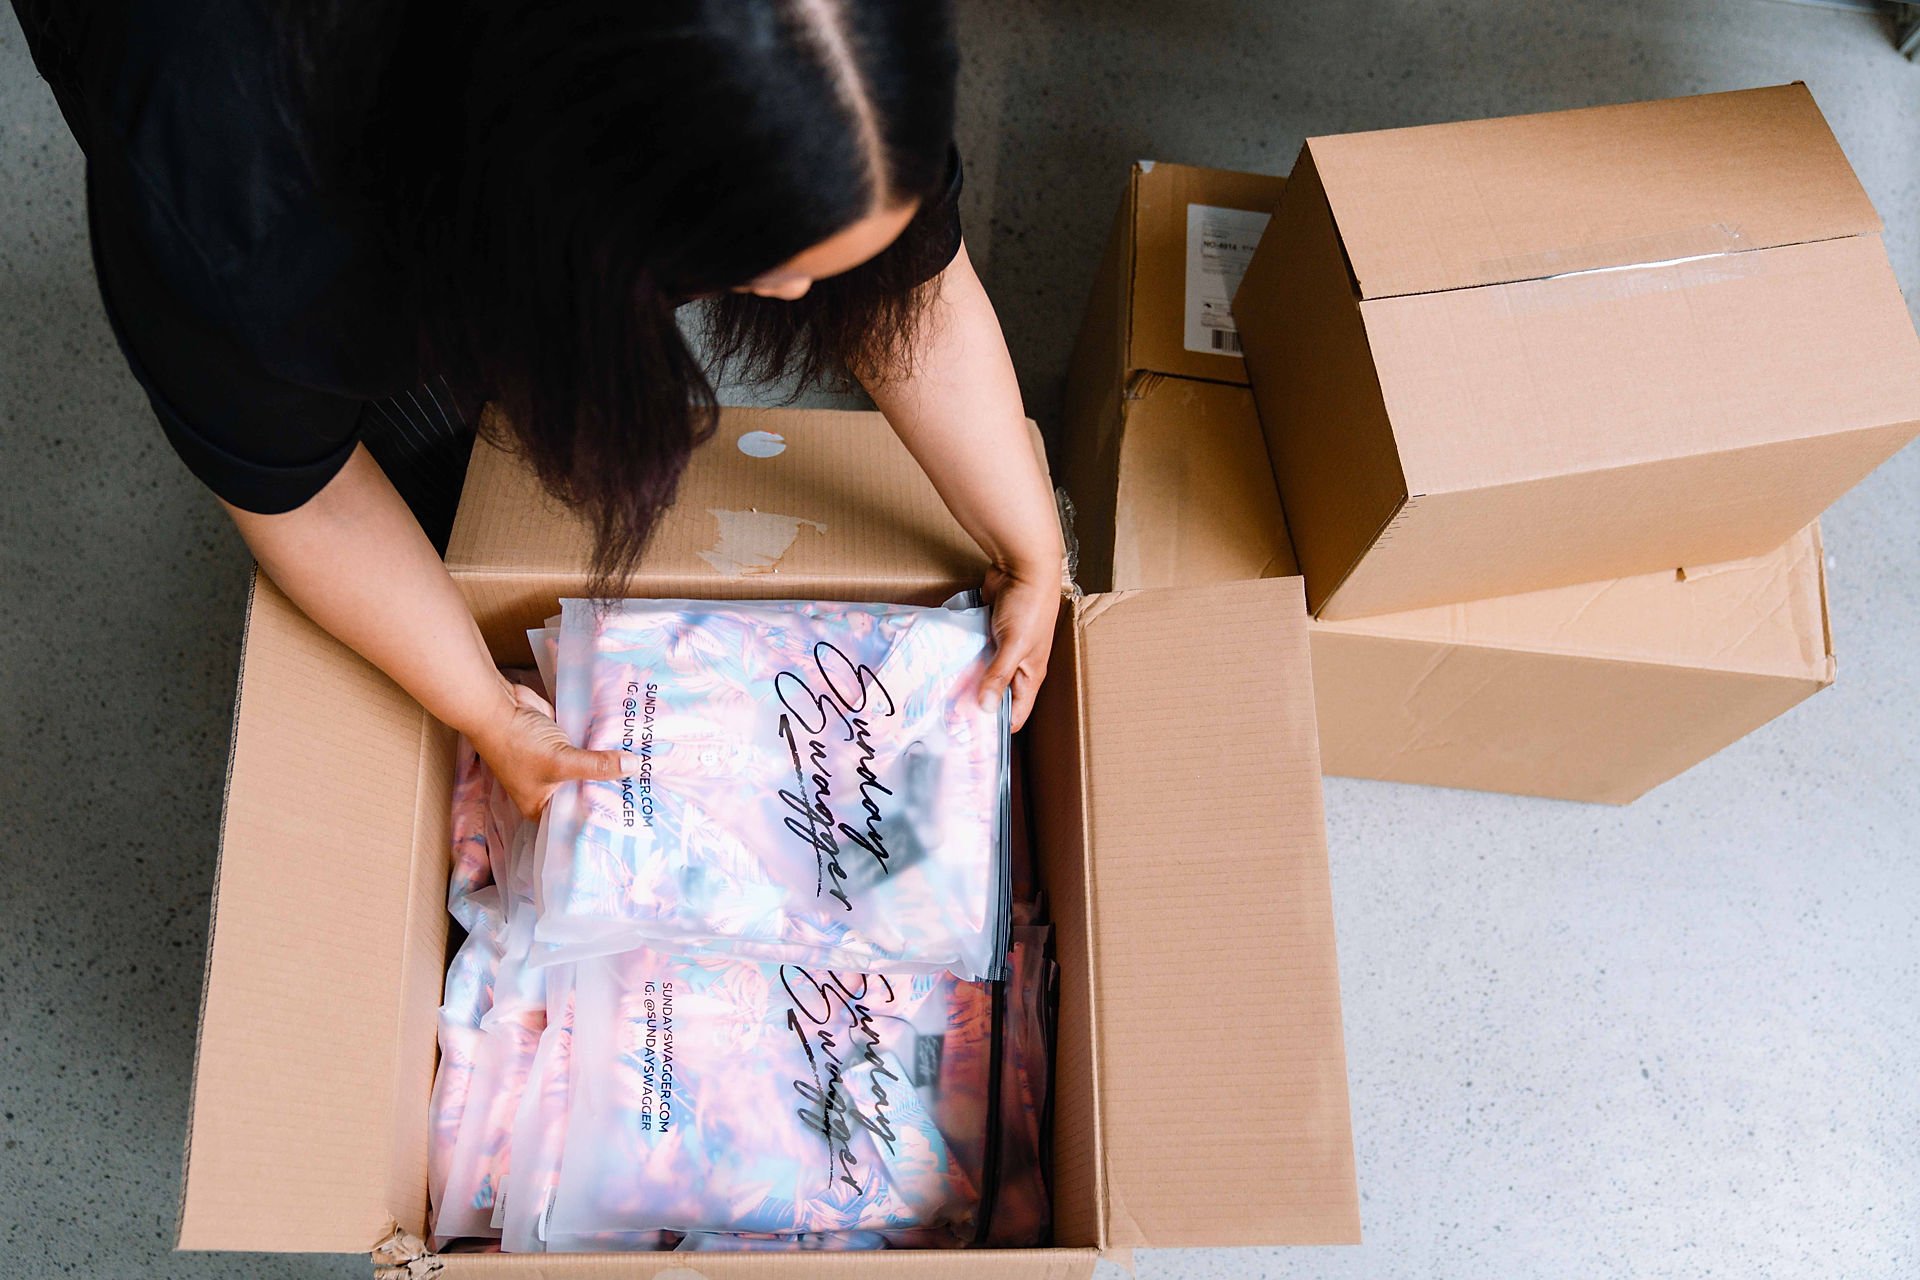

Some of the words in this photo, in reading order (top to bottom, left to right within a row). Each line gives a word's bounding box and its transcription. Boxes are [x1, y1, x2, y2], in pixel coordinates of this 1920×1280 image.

[627, 681, 639, 695] IG:
[639, 683, 658, 827] SUNDAYSWAGGER.COM
[814, 641, 894, 875] Sunday
[622, 697, 637, 828] @SUNDAGGER
[775, 671, 853, 911] Swagger
[644, 981, 656, 996] IG:
[659, 982, 673, 1133] SUNDAYSWAGGER.COM
[641, 998, 657, 1131] @SUNDAYSWAGGER
[780, 964, 863, 1195] Swagger
